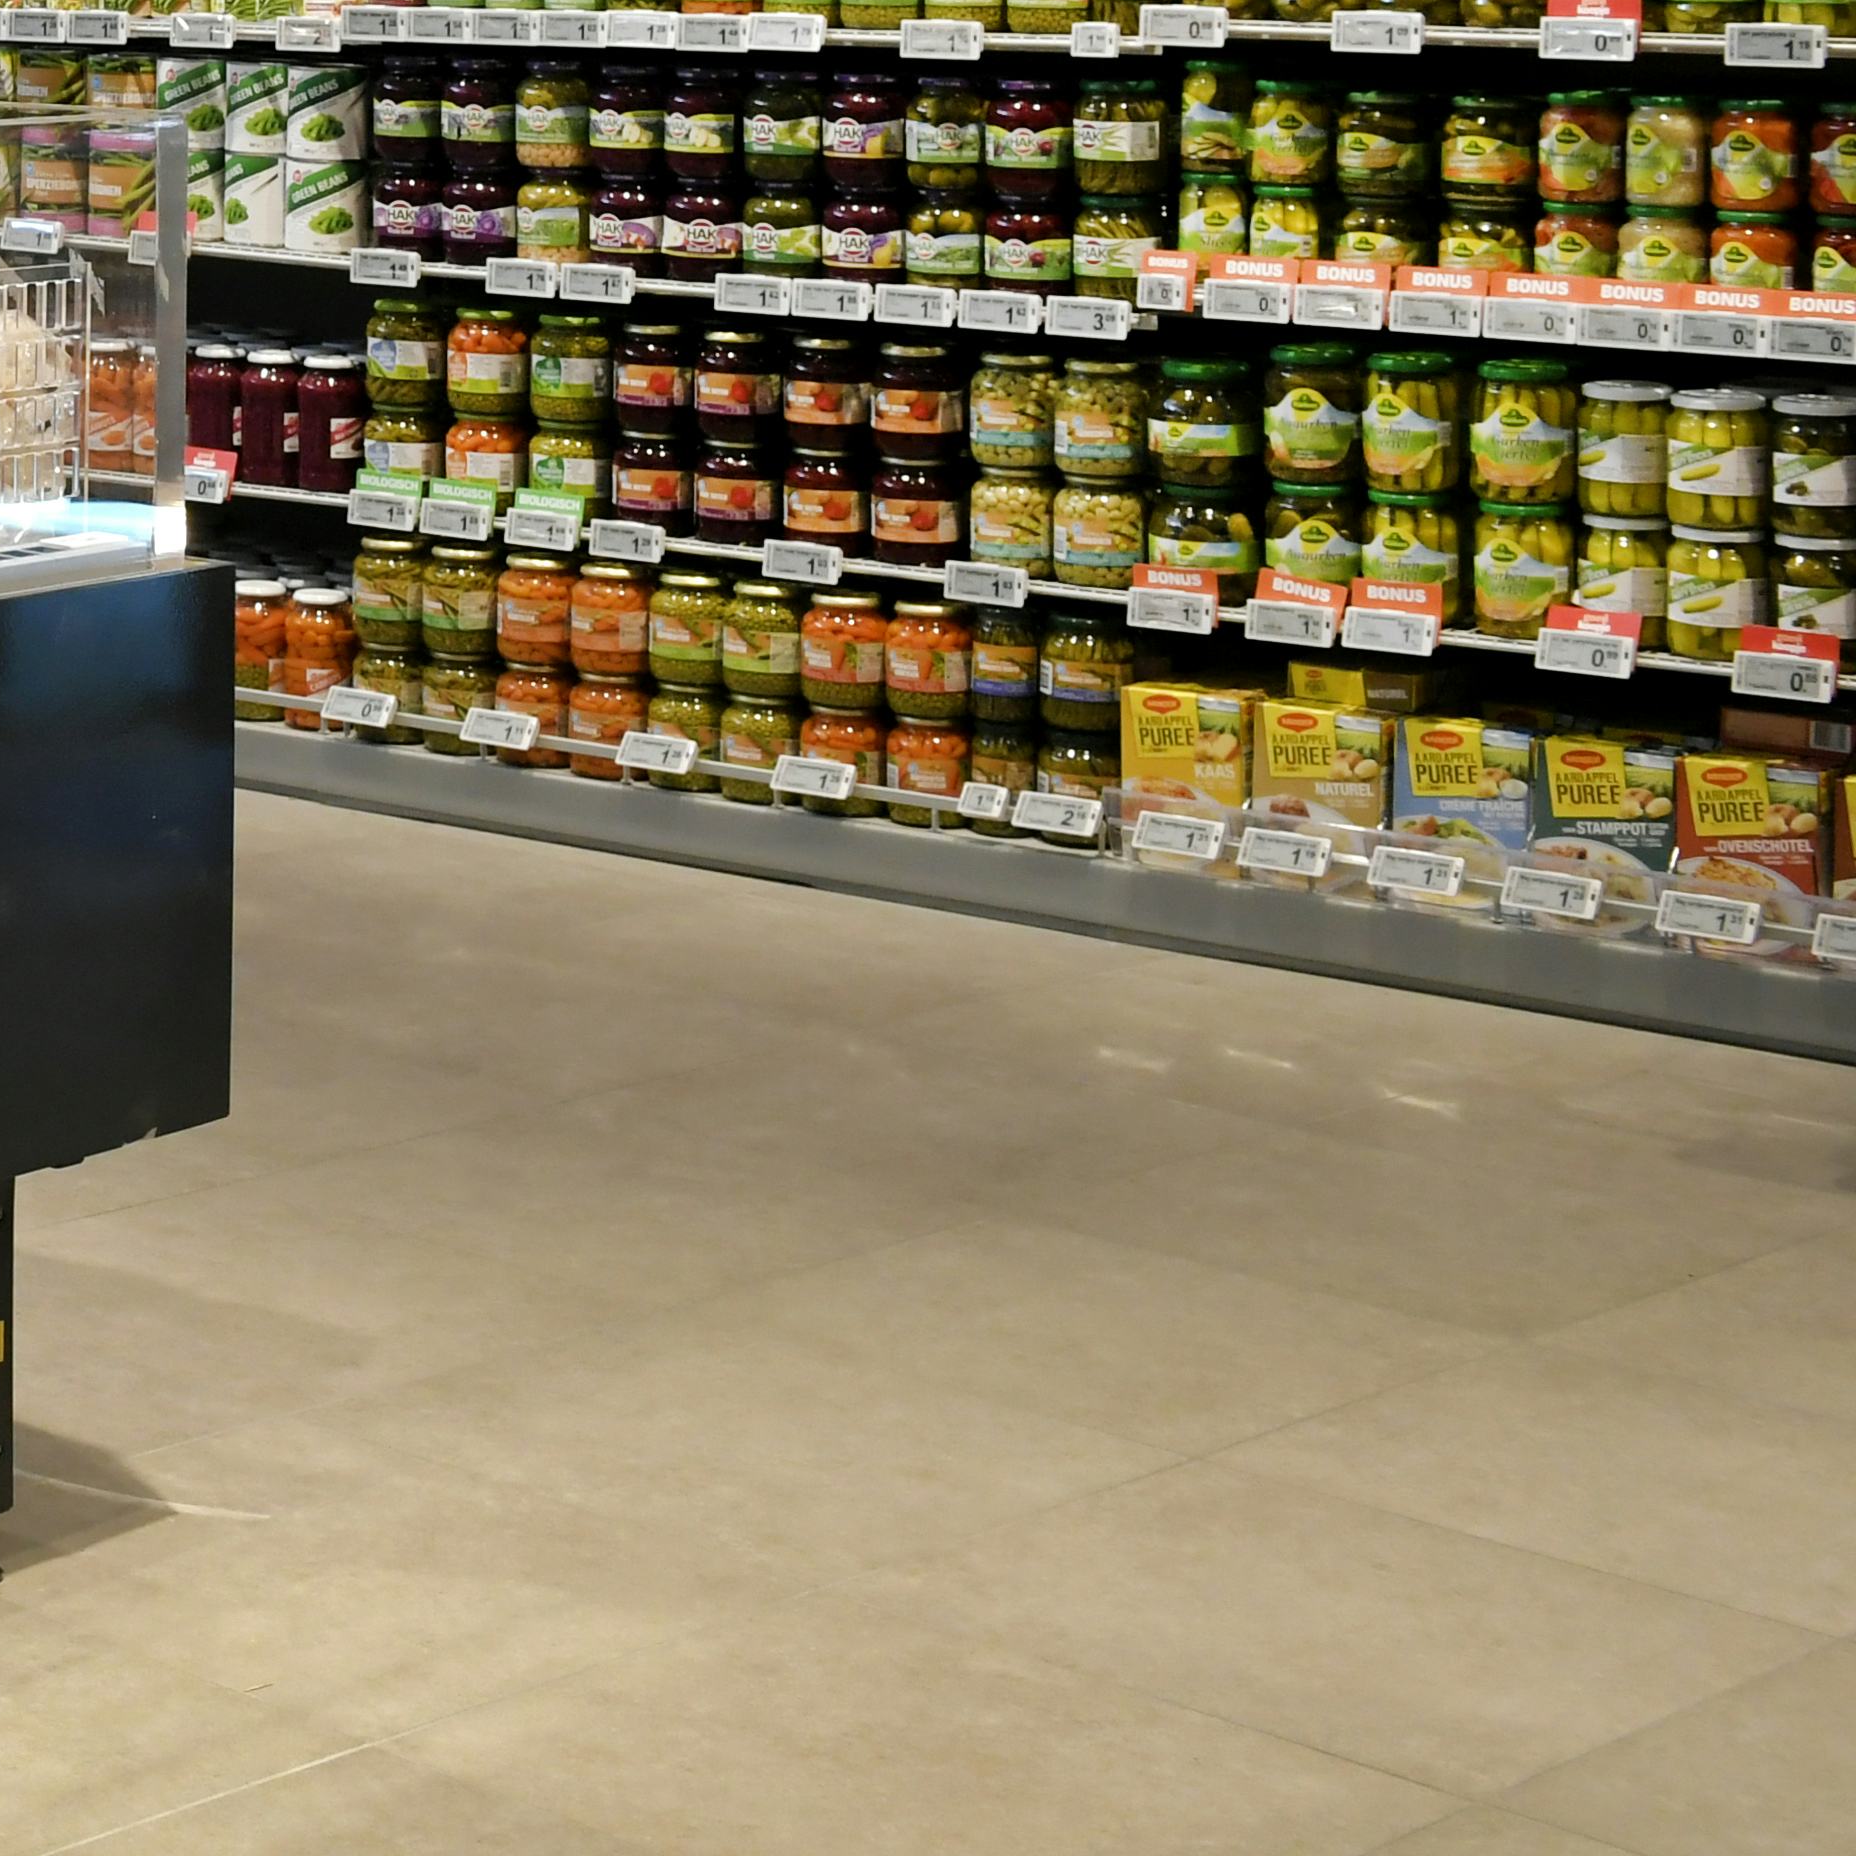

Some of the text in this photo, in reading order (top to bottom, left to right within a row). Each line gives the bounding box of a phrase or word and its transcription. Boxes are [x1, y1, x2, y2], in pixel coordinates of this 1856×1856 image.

[164, 69, 221, 101] GREEN BEANS
[833, 126, 862, 141] HAK
[292, 172, 348, 203] GREEN BEANS
[388, 209, 415, 226] HAK
[687, 227, 716, 244] HAK
[839, 236, 869, 252] HAK
[1148, 256, 1188, 269] BONUS
[1225, 260, 1284, 277] BONUS
[1316, 265, 1376, 283] BONUS
[1412, 271, 1472, 289] BONUS
[1506, 277, 1569, 296] BONUS
[1600, 284, 1664, 302] BONUS
[1695, 291, 1760, 309] BONUS
[1789, 297, 1855, 314] BONUS
[359, 473, 419, 491] BIOLOGISCH
[432, 482, 492, 501] BIOLOGISCH
[519, 493, 581, 511] BIOLOGISCH
[1147, 570, 1202, 586] BONUS
[1272, 576, 1331, 603] BONUS
[1367, 584, 1426, 603] BONUS
[1138, 715, 1193, 726] AARDAPPEL
[1140, 727, 1195, 746] PUREE
[1271, 733, 1329, 746] AARDAPPEL
[1273, 745, 1332, 766] PUREE
[1414, 751, 1476, 764] AARDAPPEL
[1194, 763, 1235, 780] KAAS
[1415, 764, 1478, 785] PUREE
[1555, 772, 1618, 785] AARDAPPEL
[1315, 781, 1374, 798] NATUREL
[1556, 784, 1621, 805] PUREE
[1697, 789, 1761, 802] AARDAPPEL
[1699, 801, 1765, 824] PUREE
[1576, 821, 1647, 836] STAMPPOT
[1718, 840, 1813, 853] OVENSCHOTEL
